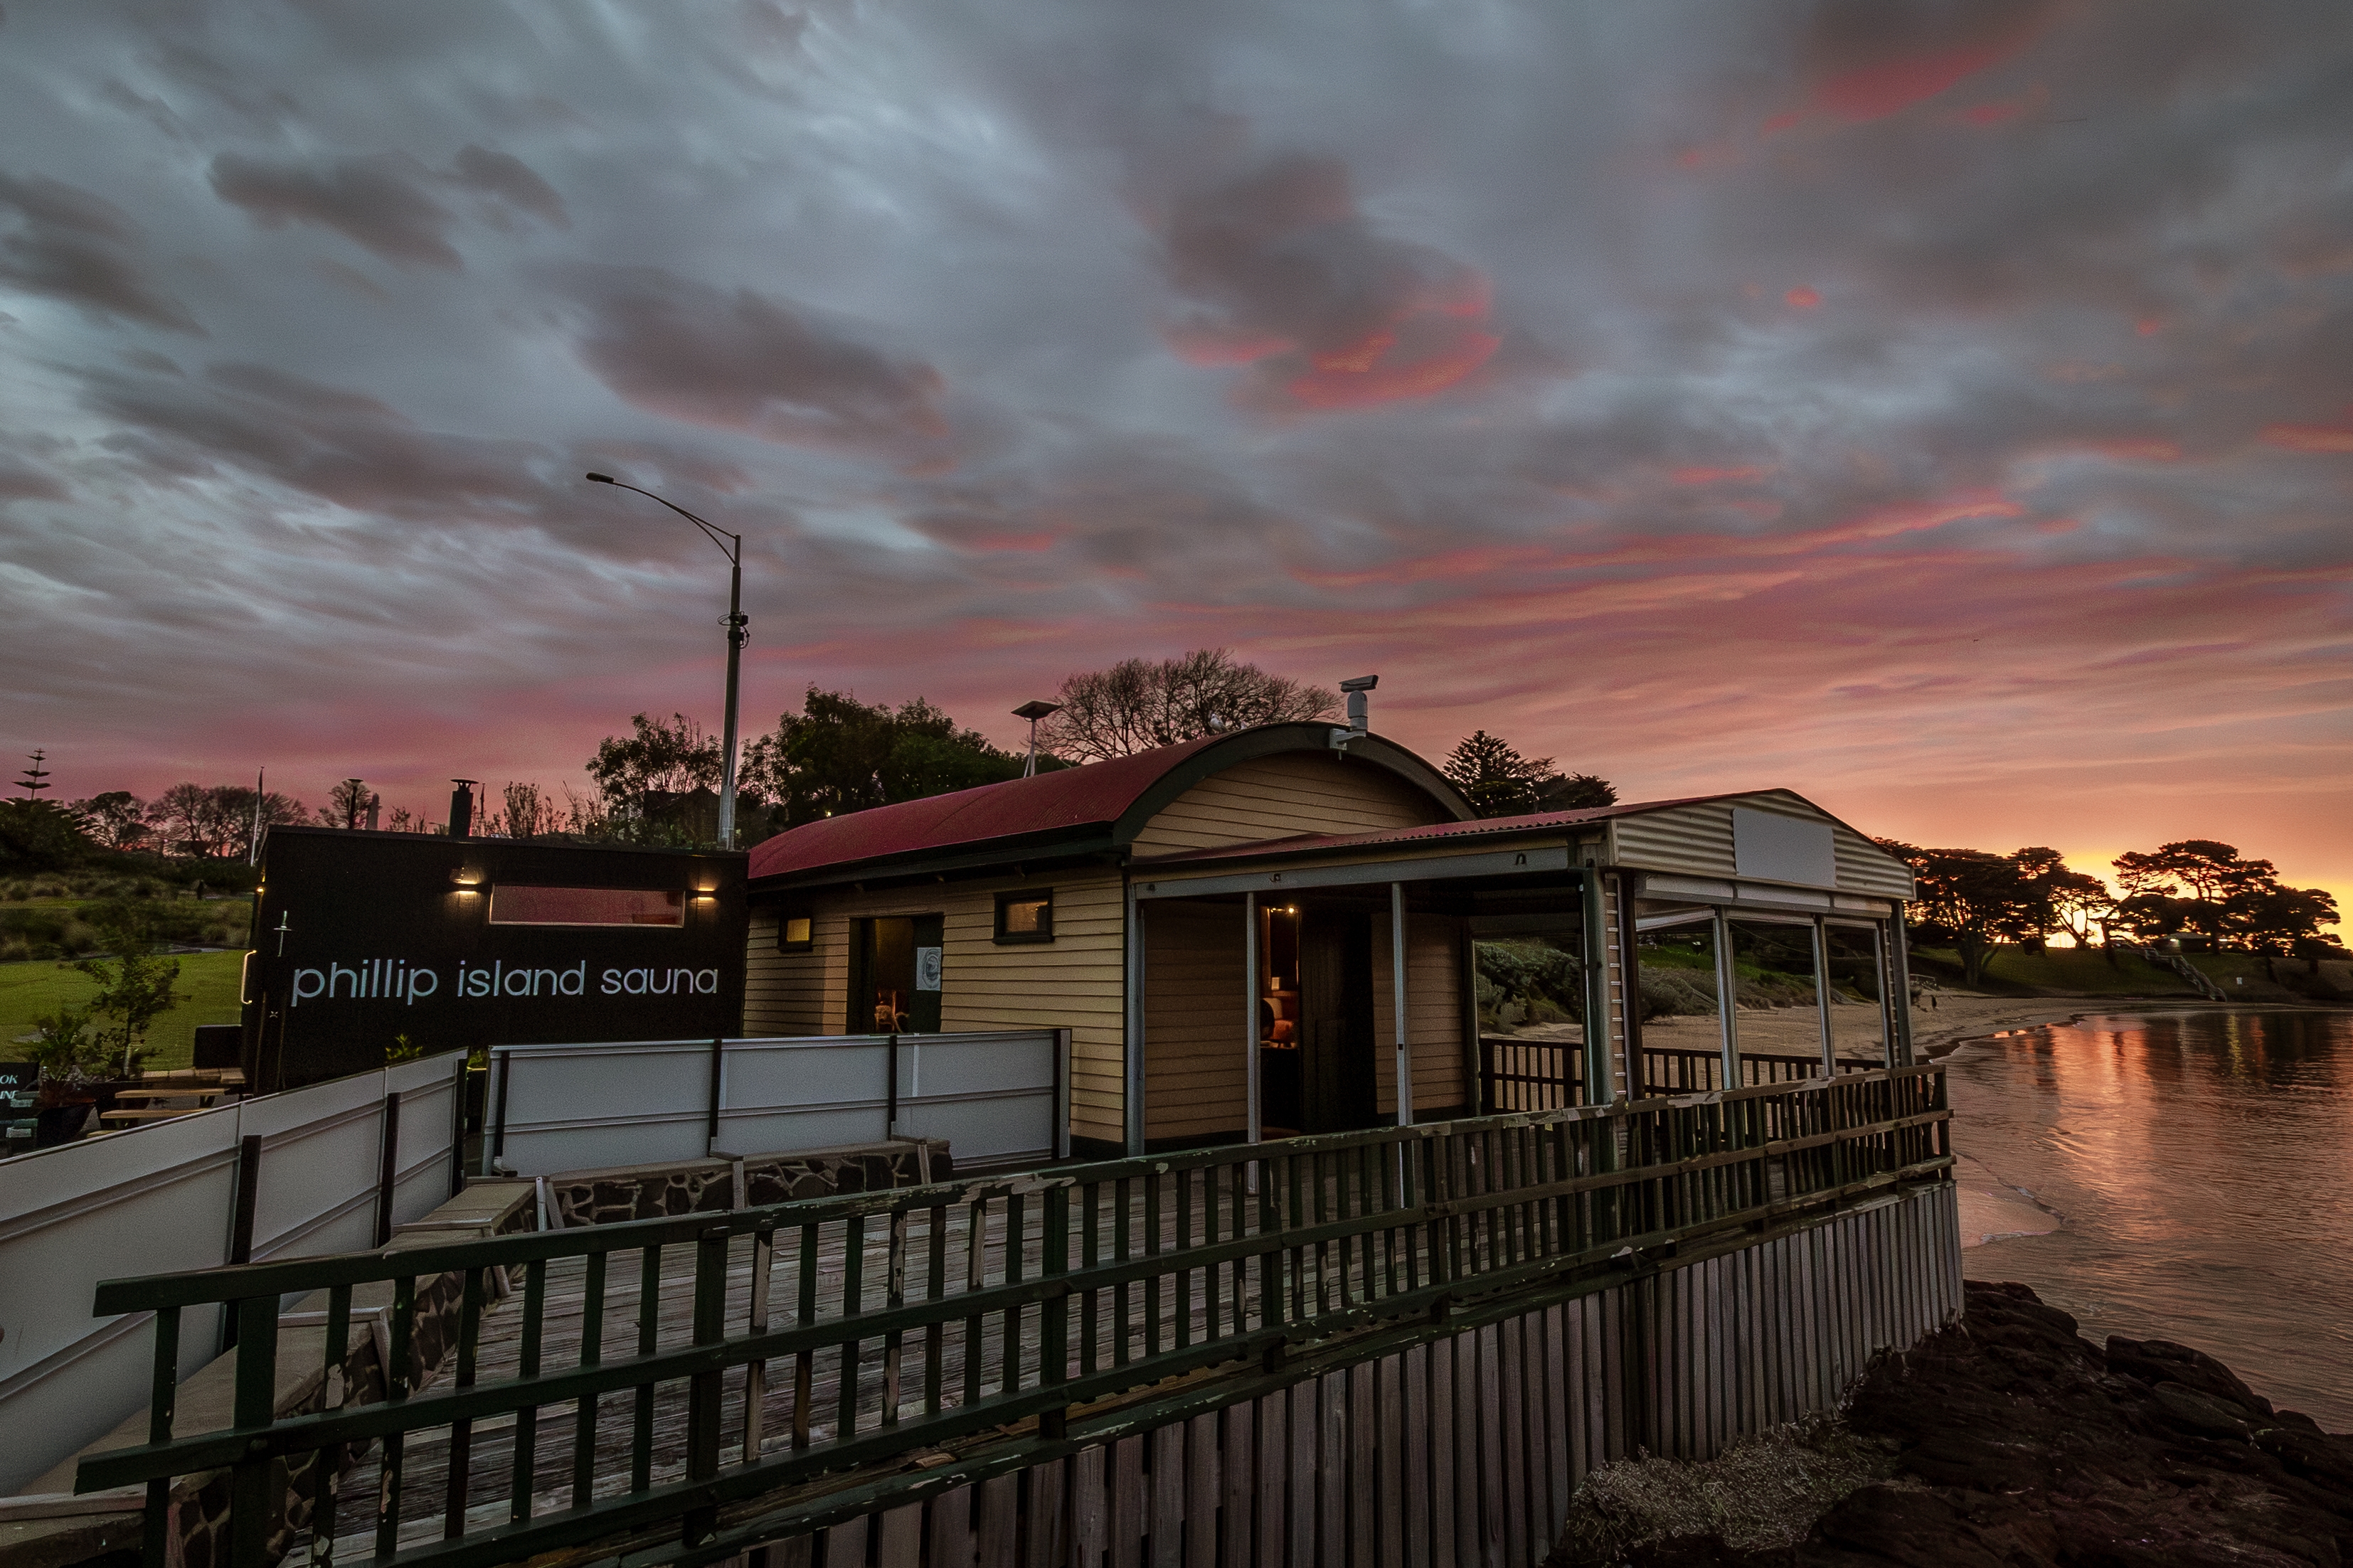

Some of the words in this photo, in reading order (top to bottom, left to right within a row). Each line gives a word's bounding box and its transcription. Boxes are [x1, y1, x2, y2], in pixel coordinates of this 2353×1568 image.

[291, 959, 438, 1007] phillip
[457, 960, 586, 997] island
[600, 969, 718, 995] sauna
